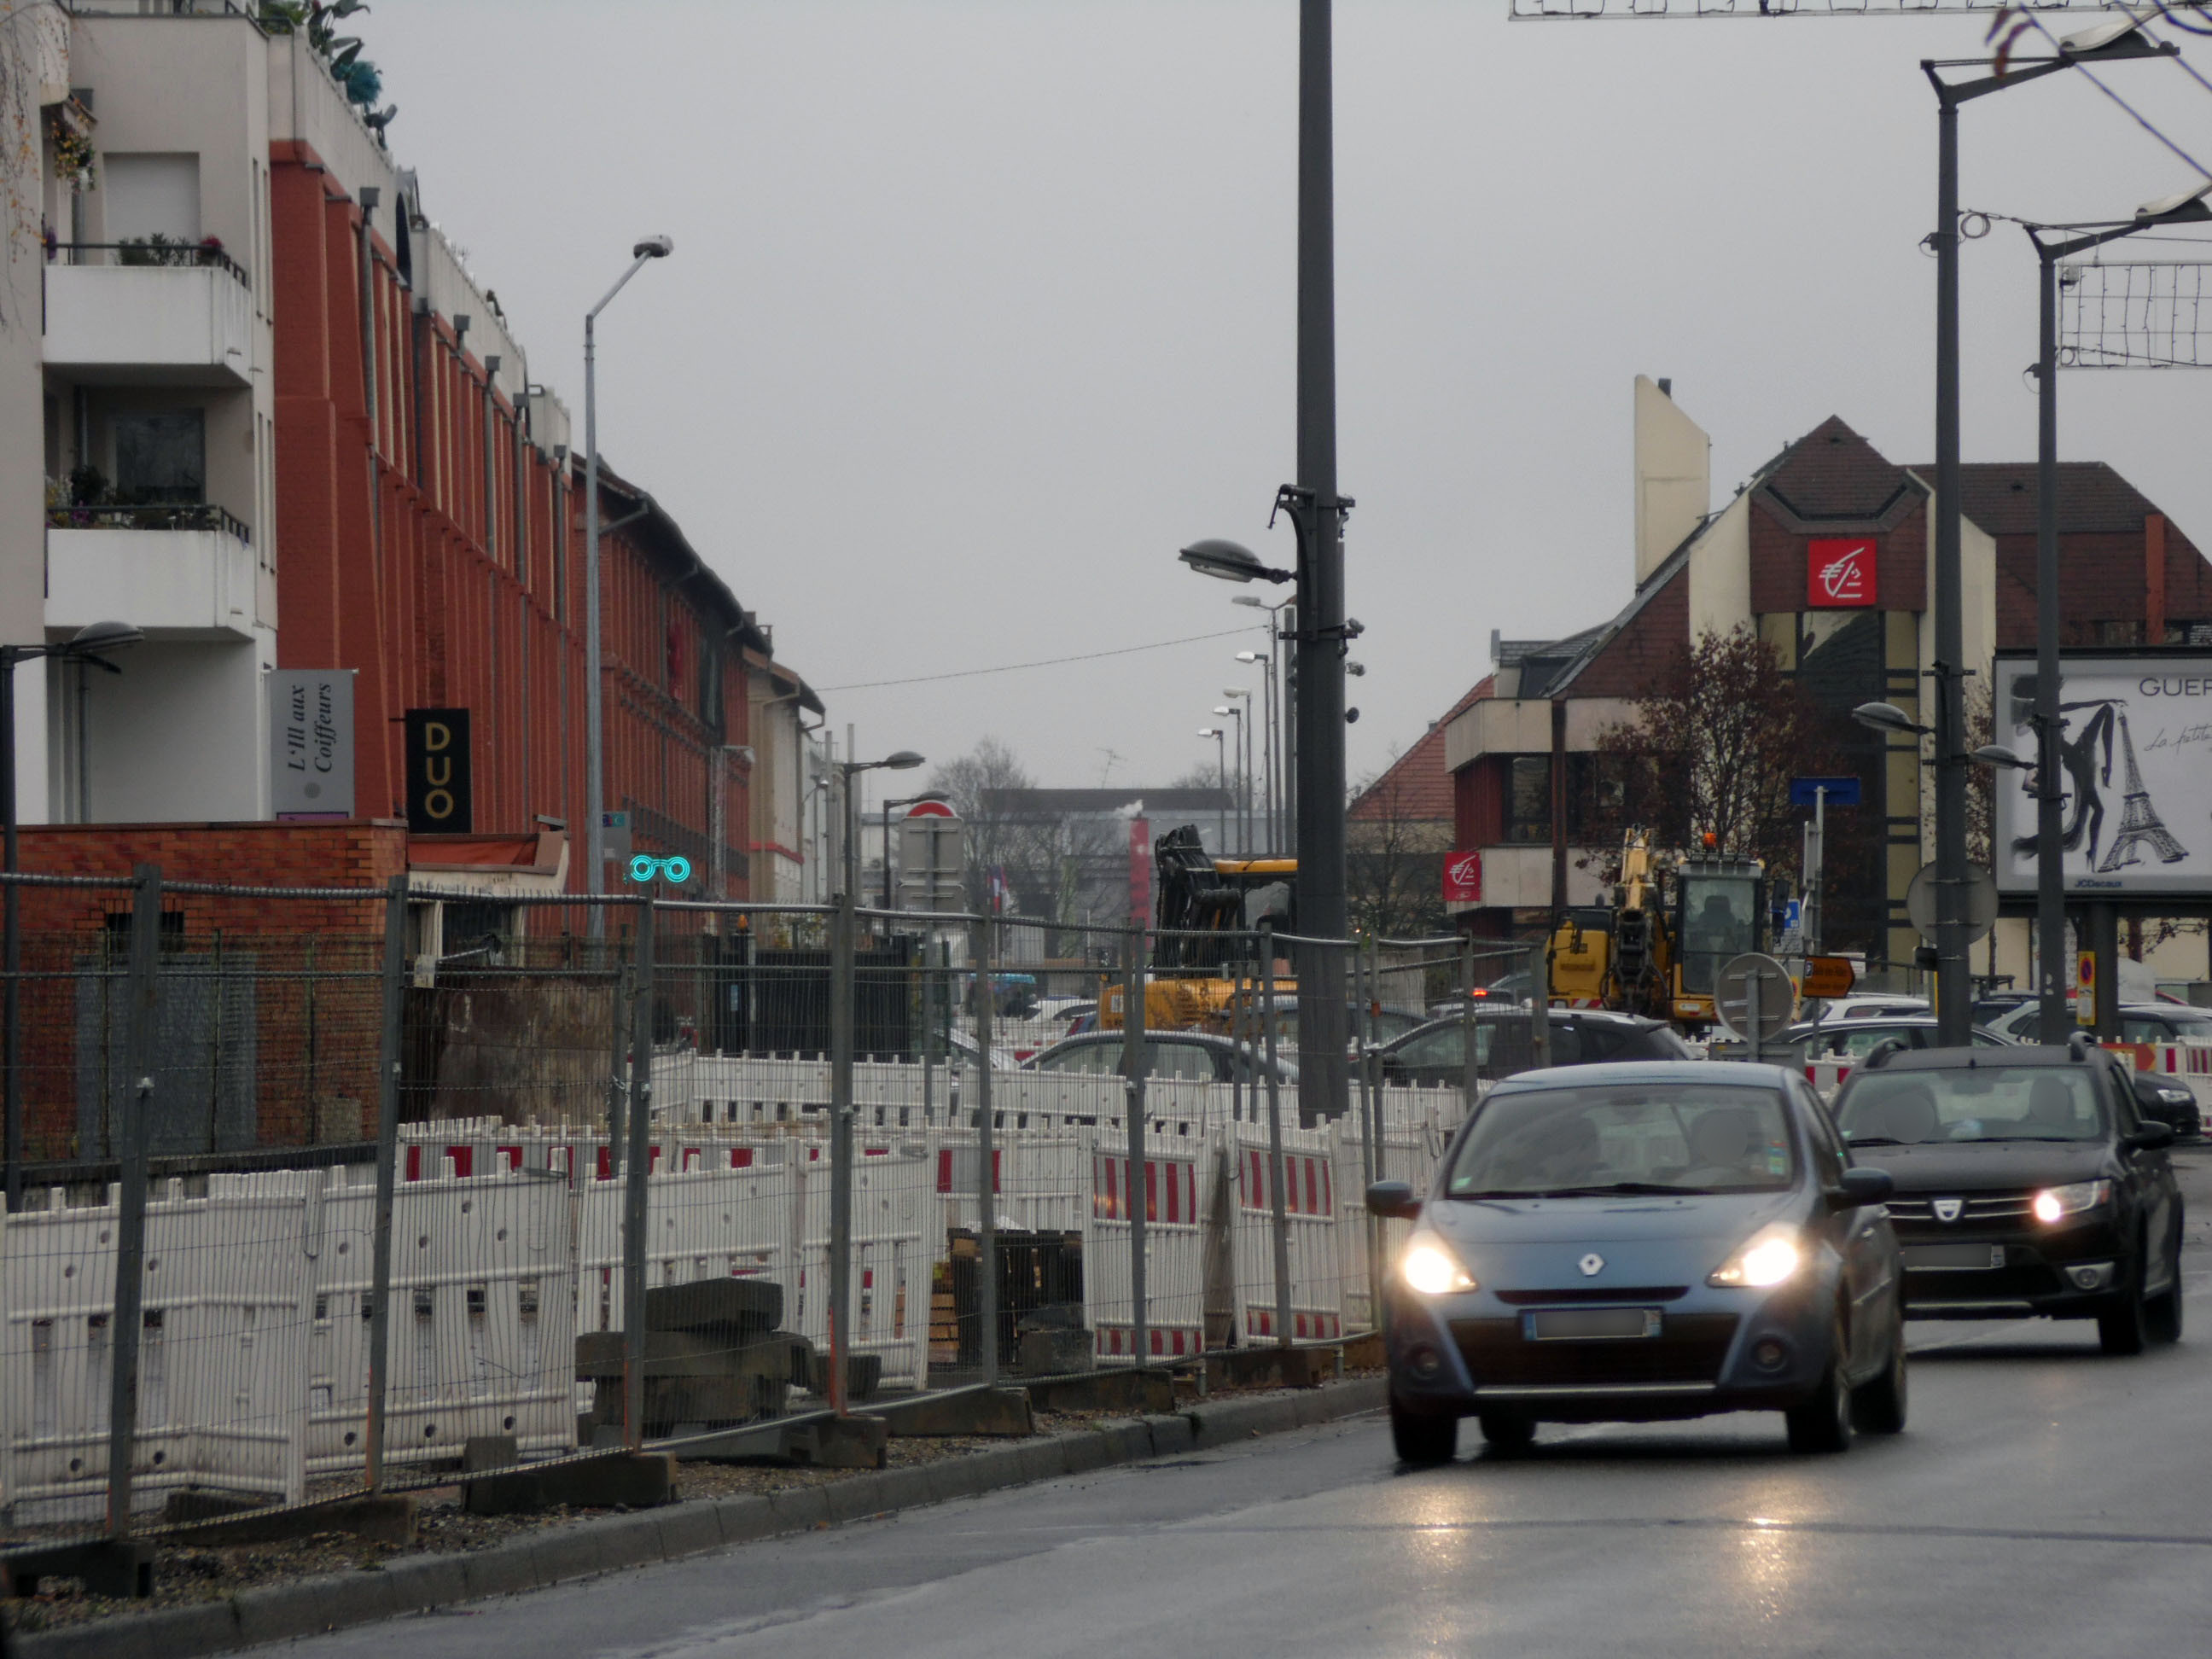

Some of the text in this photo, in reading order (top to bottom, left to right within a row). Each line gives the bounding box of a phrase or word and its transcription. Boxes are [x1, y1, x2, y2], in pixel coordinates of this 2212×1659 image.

[293, 685, 305, 721] aux
[315, 684, 336, 772] Coiffeurs
[426, 722, 453, 818] DUO
